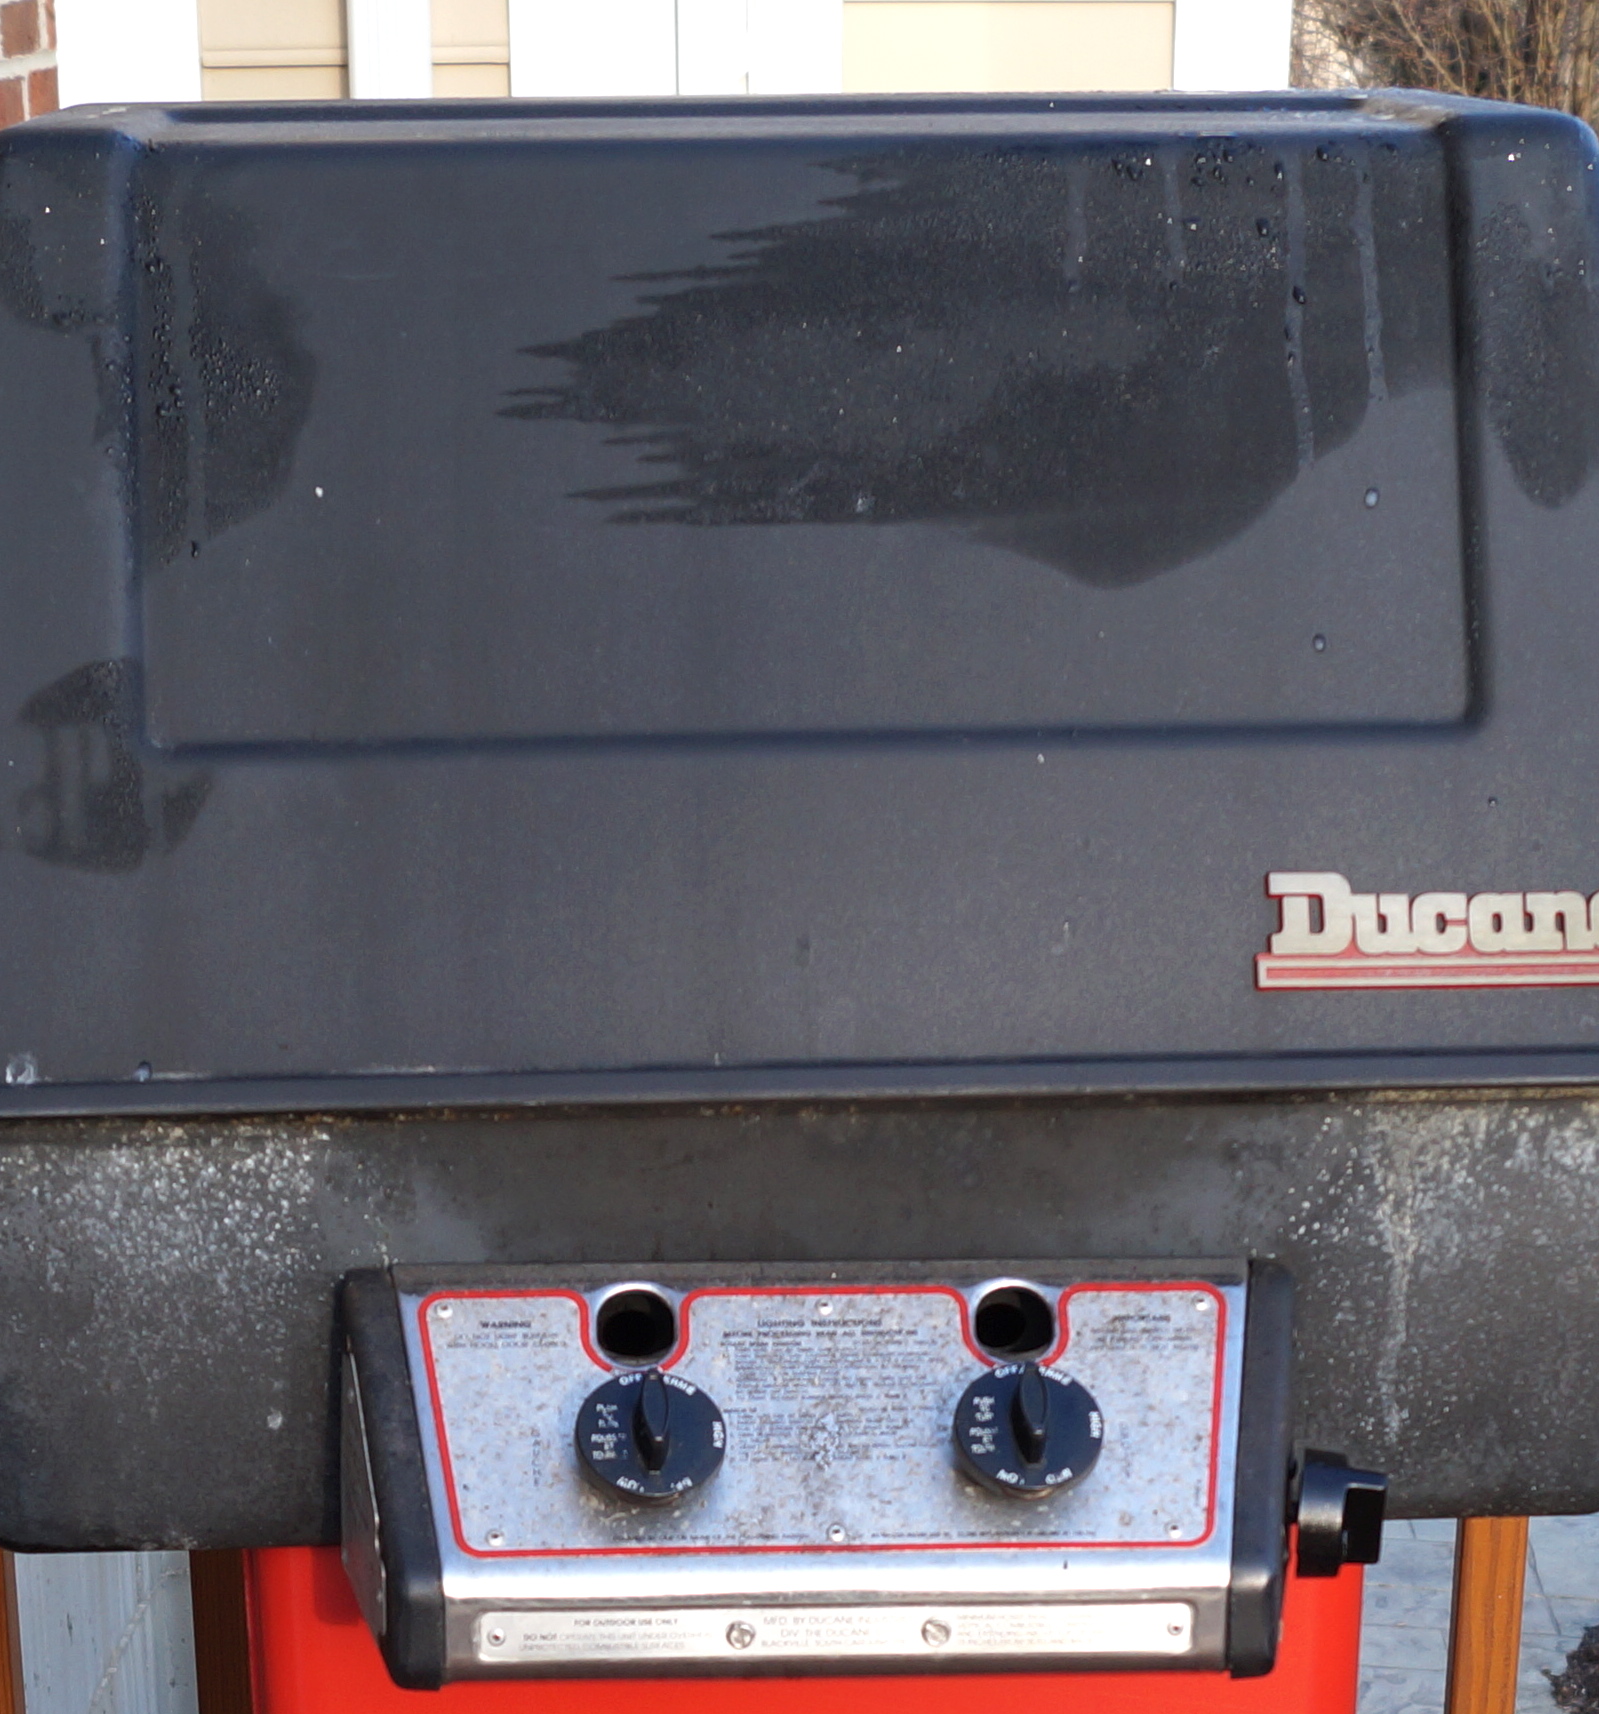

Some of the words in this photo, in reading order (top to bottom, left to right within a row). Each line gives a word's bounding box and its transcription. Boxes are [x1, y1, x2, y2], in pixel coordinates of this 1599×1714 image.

[574, 1618, 591, 1627] FOR
[593, 1618, 636, 1627] OUTDOOR
[638, 1618, 653, 1627] USE
